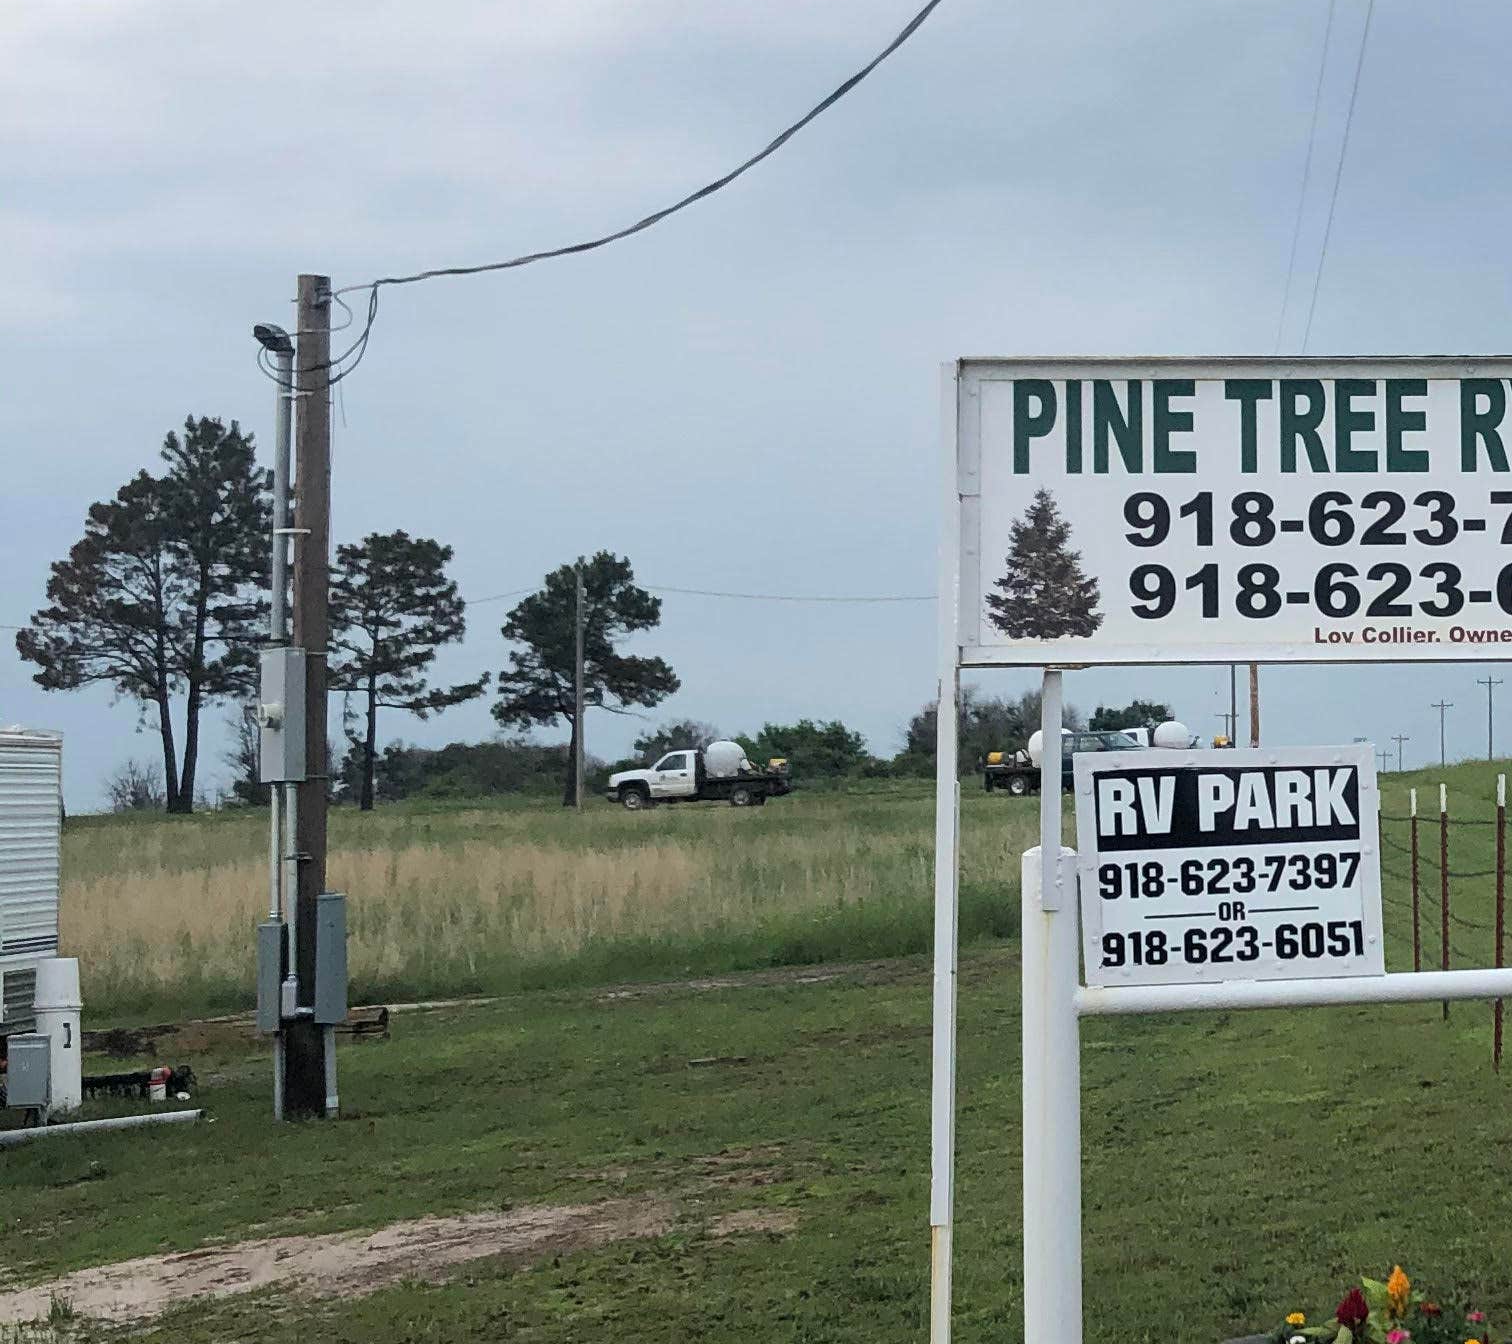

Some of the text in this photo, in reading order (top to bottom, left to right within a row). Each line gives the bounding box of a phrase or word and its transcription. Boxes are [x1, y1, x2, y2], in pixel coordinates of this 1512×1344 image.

[1012, 378, 1197, 475] PINE
[1225, 378, 1430, 474] TREE
[1098, 767, 1357, 837] RV PARK
[1098, 851, 1361, 900] 918-623-7397
[1218, 901, 1246, 921] OR
[1100, 920, 1365, 968] 918-623-6051
